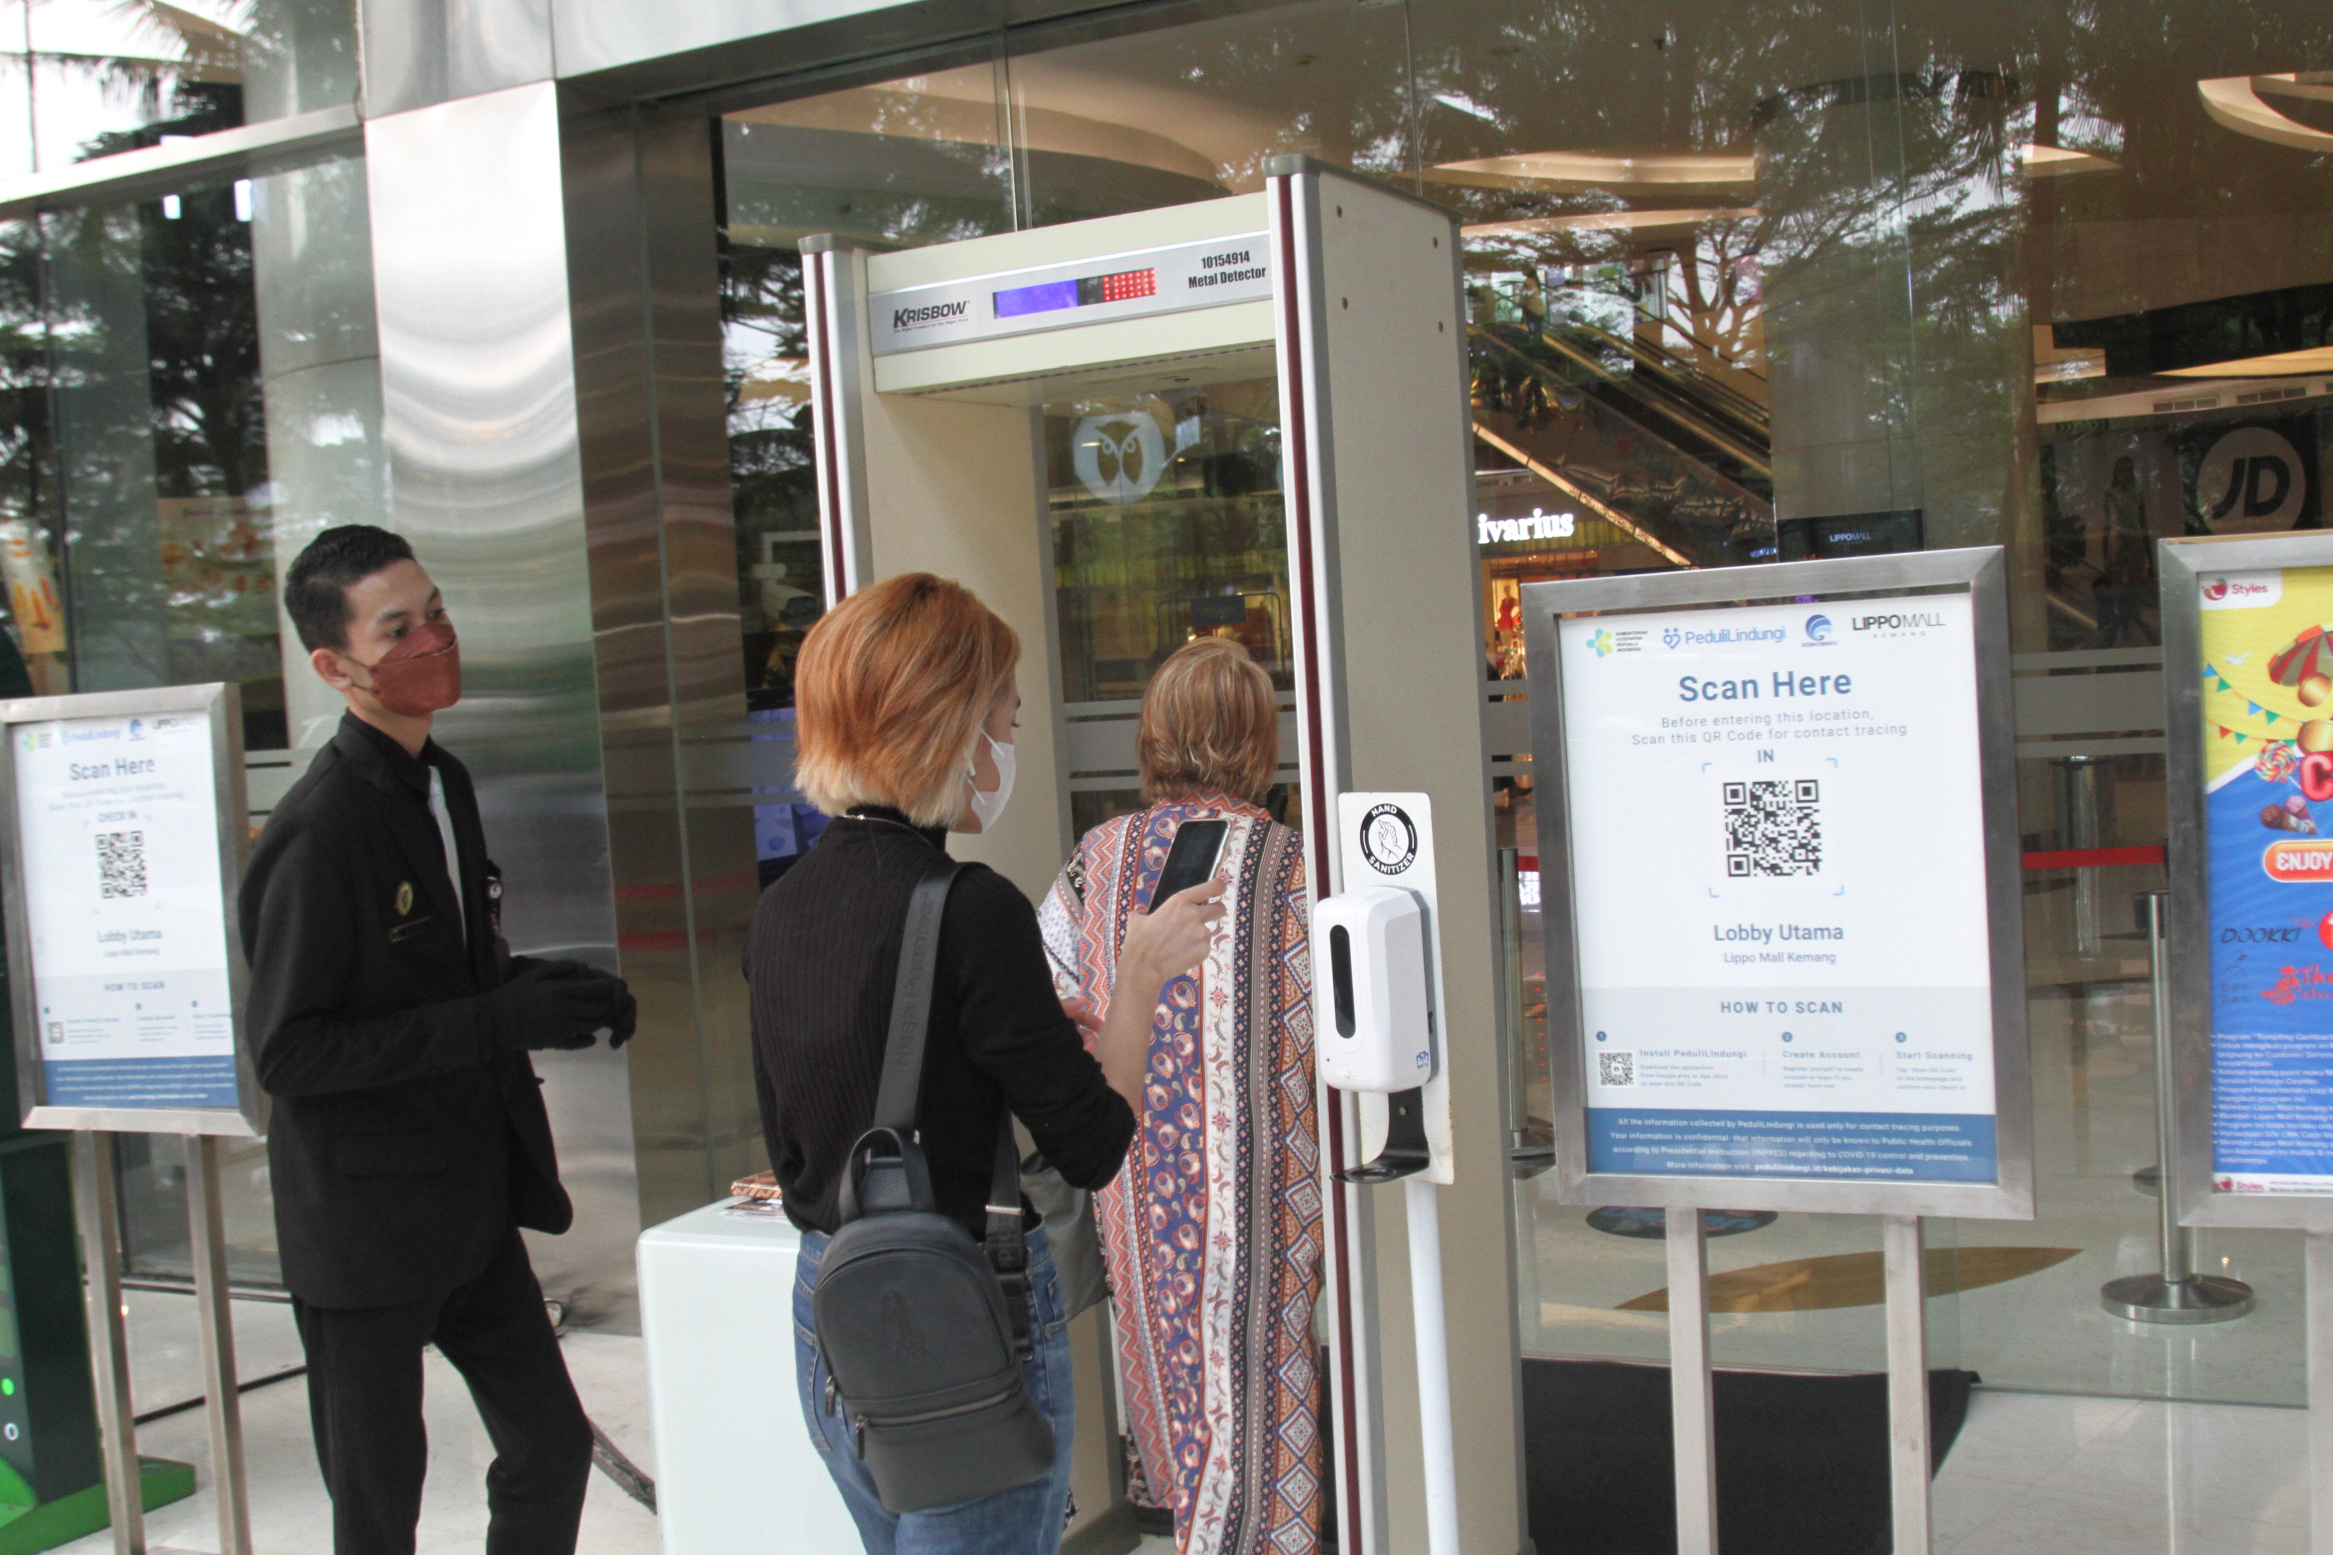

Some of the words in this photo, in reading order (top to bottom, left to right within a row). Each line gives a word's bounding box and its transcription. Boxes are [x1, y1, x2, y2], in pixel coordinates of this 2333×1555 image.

[1201, 250, 1250, 269] 10154914
[1188, 273, 1218, 289] Metal
[1220, 267, 1266, 284] Detector
[893, 300, 966, 329] KRISBOW
[2213, 455, 2291, 520] JD
[2231, 584, 2268, 596] Styles
[1685, 626, 1786, 645] PeduliLindungi
[1679, 675, 1759, 702] Scan
[1772, 670, 1852, 698] Here
[1661, 717, 1708, 729] Before
[1713, 714, 1772, 727] entering
[1777, 711, 1804, 723] this
[1809, 709, 1875, 722] location,
[1632, 733, 1666, 746] Scan
[1671, 731, 1697, 744] this
[1703, 730, 1722, 743] QR
[1727, 729, 1763, 742] Code
[1769, 727, 1789, 740] for
[1794, 726, 1850, 739] contact
[1855, 723, 1908, 737] tracing
[1757, 749, 1775, 763] IN
[70, 763, 110, 781] Scan
[115, 758, 156, 777] Here
[1371, 804, 1398, 817] HAND
[1369, 852, 1414, 874] SANITIZER
[2276, 852, 2333, 871] ENJOY
[1714, 923, 1774, 945] Lobby
[1779, 923, 1844, 941] Utama
[1724, 952, 1756, 965] Lippo
[1759, 952, 1785, 964] Mall
[1788, 952, 1837, 965] Kemang
[1720, 1001, 1759, 1014] HOW
[1766, 1001, 1788, 1014] TO
[1795, 1001, 1843, 1014] SCAN
[1639, 1050, 1671, 1058] Install
[1674, 1050, 1748, 1059] PeduliLindungi
[1782, 1051, 1816, 1059] Create
[1819, 1051, 1861, 1060] Account
[1896, 1051, 1922, 1060] Start
[1925, 1052, 1973, 1062] Scanning
[1630, 1118, 1643, 1126] the
[1645, 1119, 1689, 1127] information
[1691, 1119, 1725, 1128] collected
[1727, 1120, 1736, 1129] by
[1738, 1121, 1795, 1130] PeduliLindungi
[1807, 1122, 1826, 1130] used
[1827, 1122, 1844, 1131] only
[1846, 1122, 1857, 1130] for
[1860, 1123, 1890, 1131] contact
[1892, 1124, 1920, 1132] tracing
[1629, 1132, 1673, 1140] information
[1813, 1137, 1830, 1145] only
[1844, 1137, 1870, 1145] known
[1938, 1139, 1973, 1147] Officials
[1613, 1147, 1650, 1155] according
[1661, 1147, 1707, 1155] Presidential
[1708, 1148, 1750, 1156] Instruction
[1789, 1151, 1827, 1159] regarding
[1667, 1161, 1687, 1169] More
[1688, 1162, 1732, 1170] information
